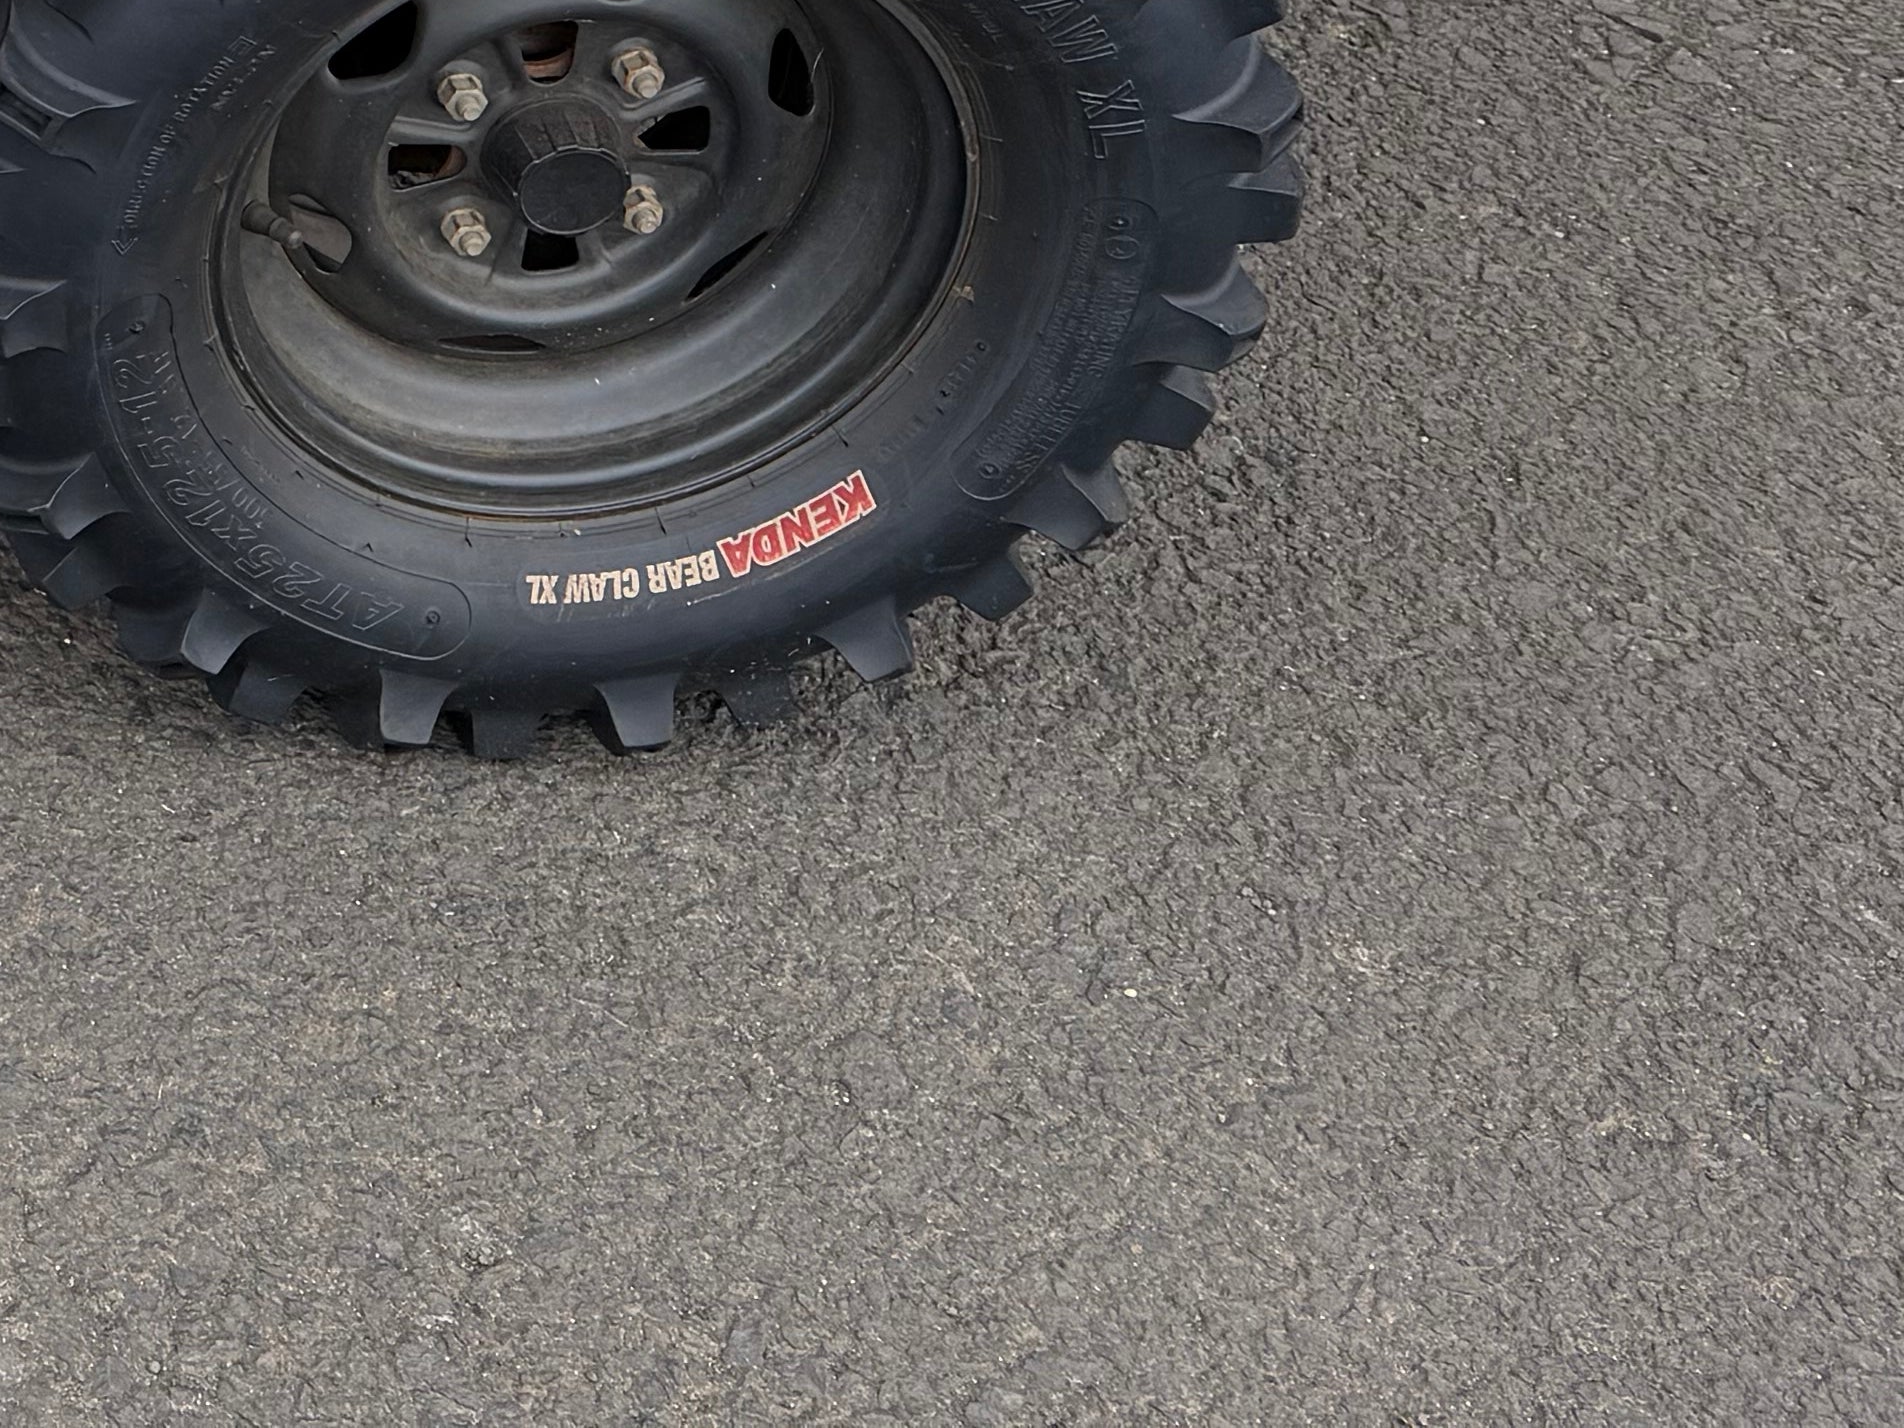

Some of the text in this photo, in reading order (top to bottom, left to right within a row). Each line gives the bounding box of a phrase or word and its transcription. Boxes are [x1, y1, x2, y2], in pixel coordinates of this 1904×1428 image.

[1076, 79, 1146, 160] XL
[525, 469, 877, 604] KENDA BEAR CLAW XL
